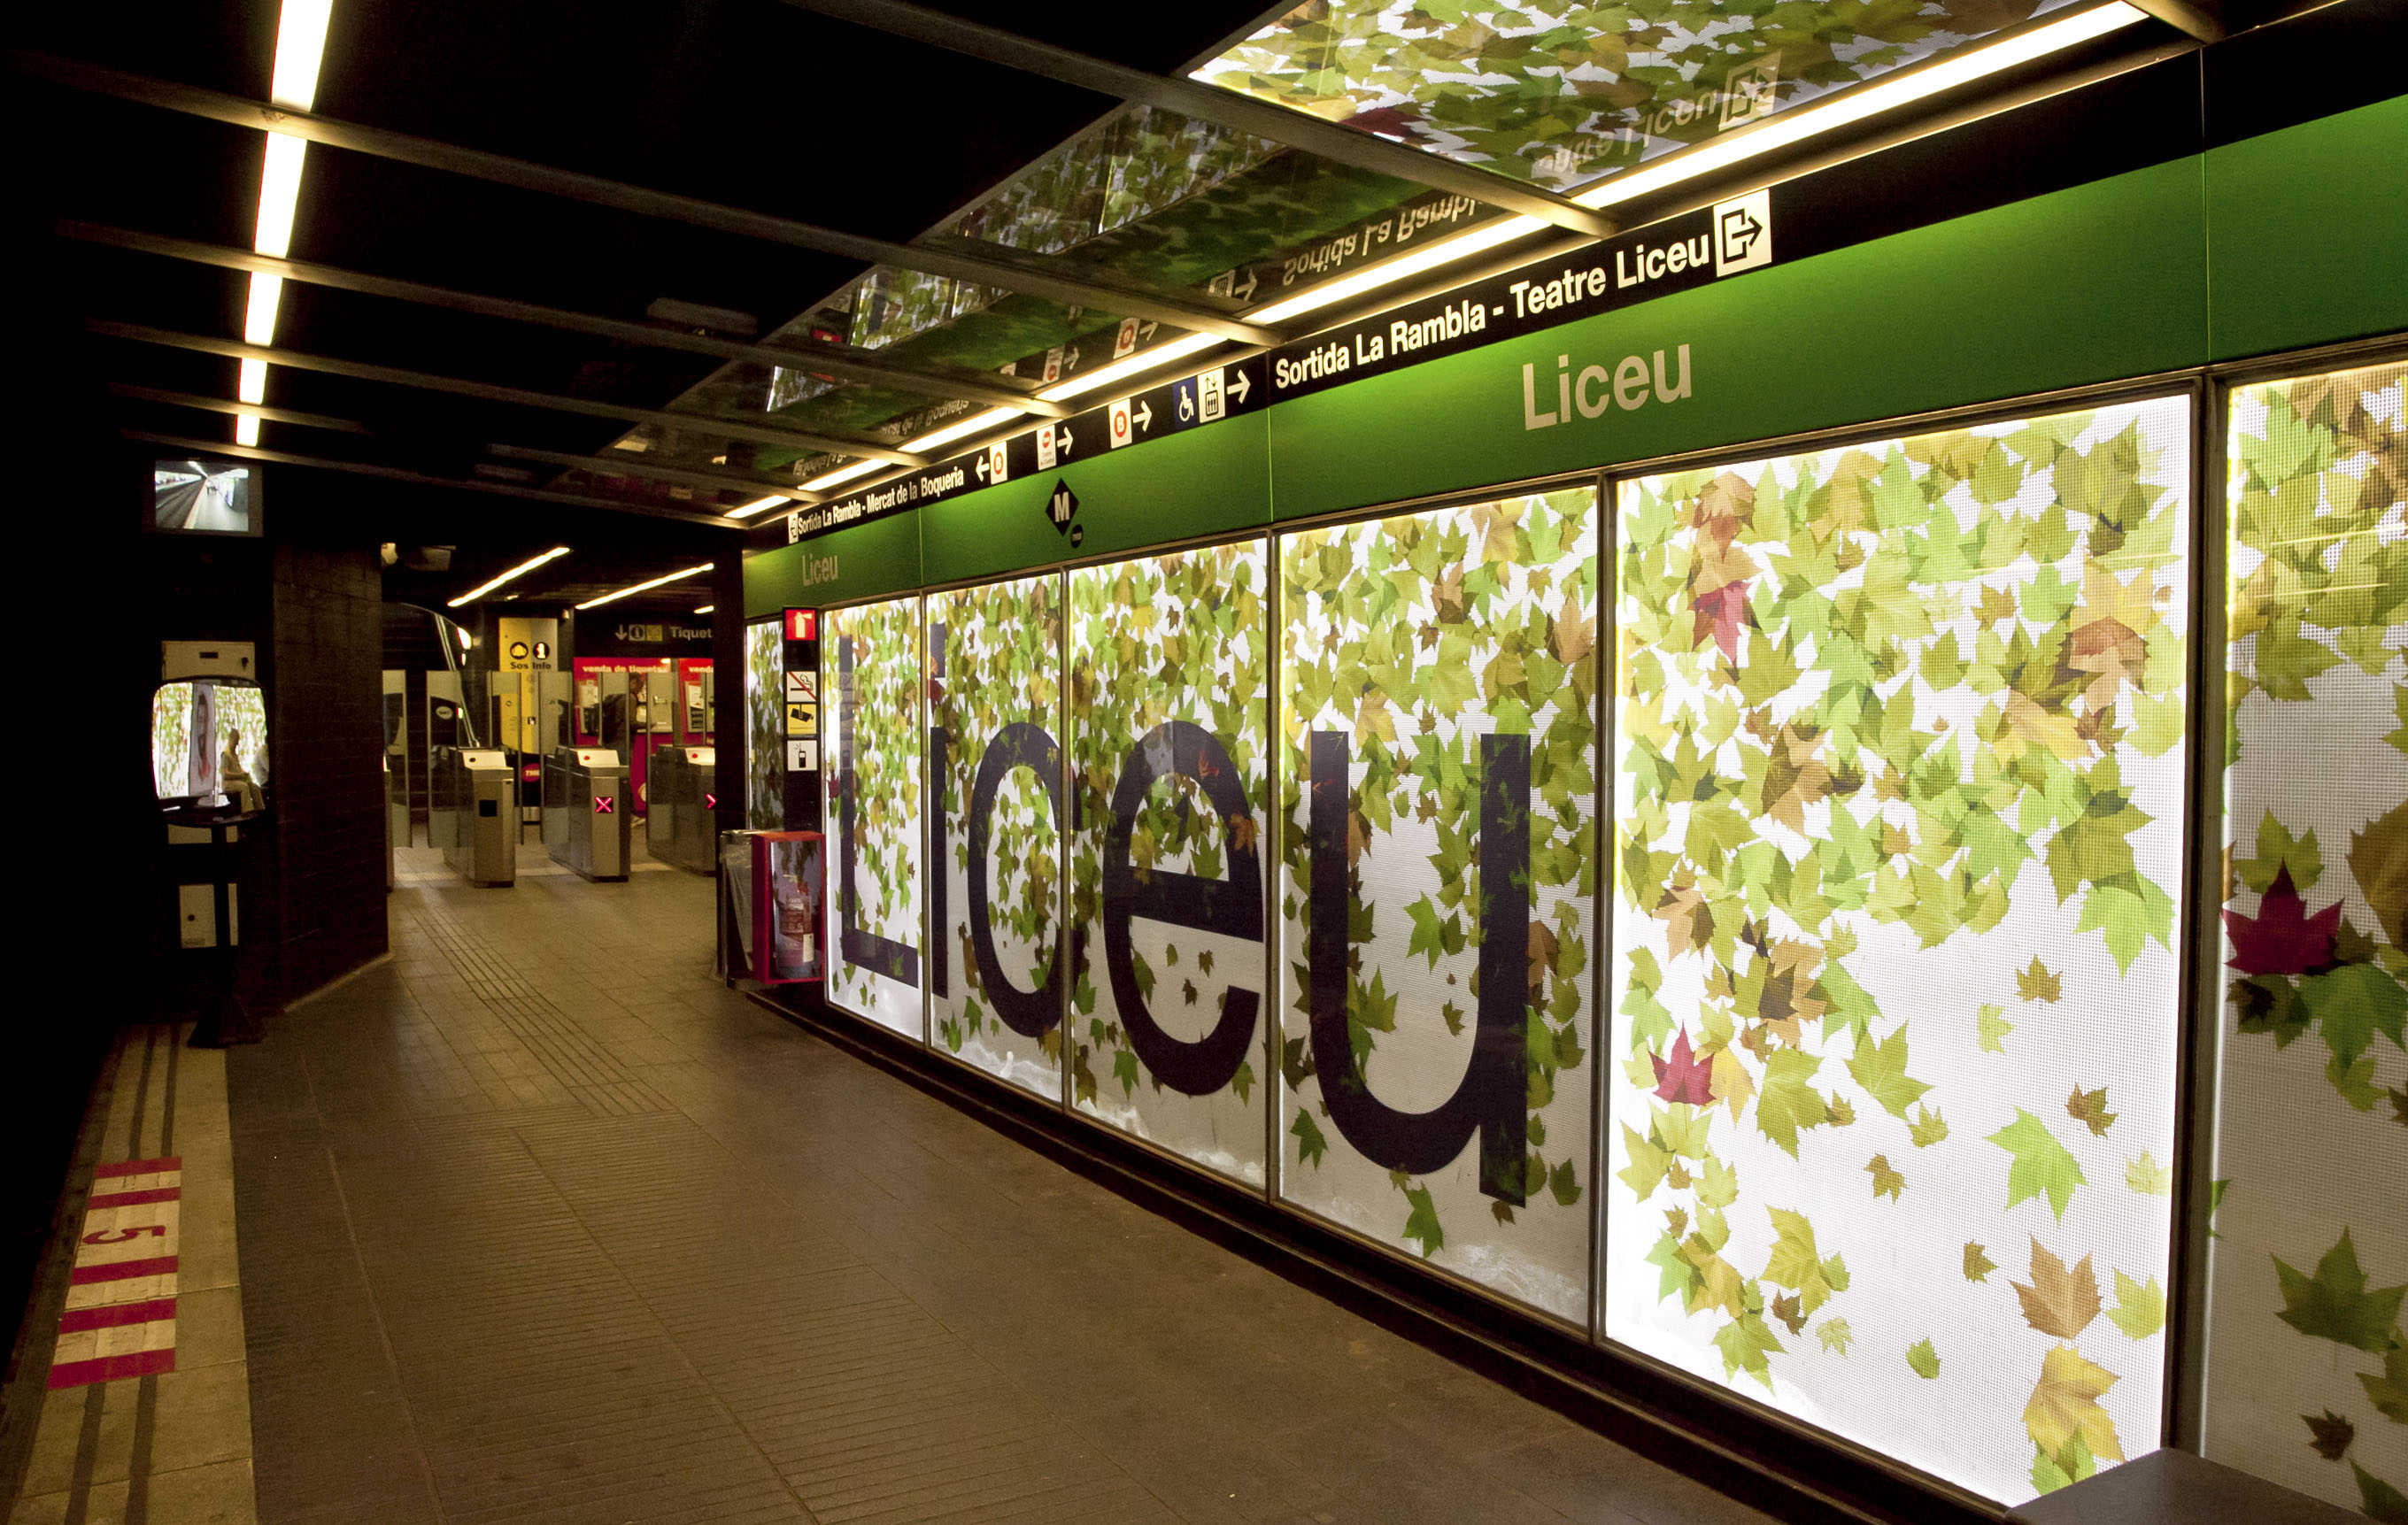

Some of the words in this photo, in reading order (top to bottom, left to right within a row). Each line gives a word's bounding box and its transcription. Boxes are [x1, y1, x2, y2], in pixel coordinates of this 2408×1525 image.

[1276, 341, 1350, 389] Sortida
[1355, 333, 1384, 366] La
[1390, 303, 1486, 356] Rambla
[1509, 268, 1606, 319] Teatre
[1617, 234, 1710, 289] Liceu
[1523, 343, 1692, 431] Liceu
[798, 512, 822, 535] Sortida
[822, 509, 832, 528] La
[832, 499, 861, 524] Rambla
[867, 488, 896, 514] Mercat
[897, 484, 908, 505] de
[909, 481, 918, 501] la
[921, 466, 965, 497] Boqueria
[1054, 491, 1070, 523] M
[802, 552, 838, 587] Liceu
[510, 661, 529, 670] Sos
[532, 661, 552, 670] Info
[838, 622, 1532, 1208] Liceu
[82, 1225, 166, 1244] 5
